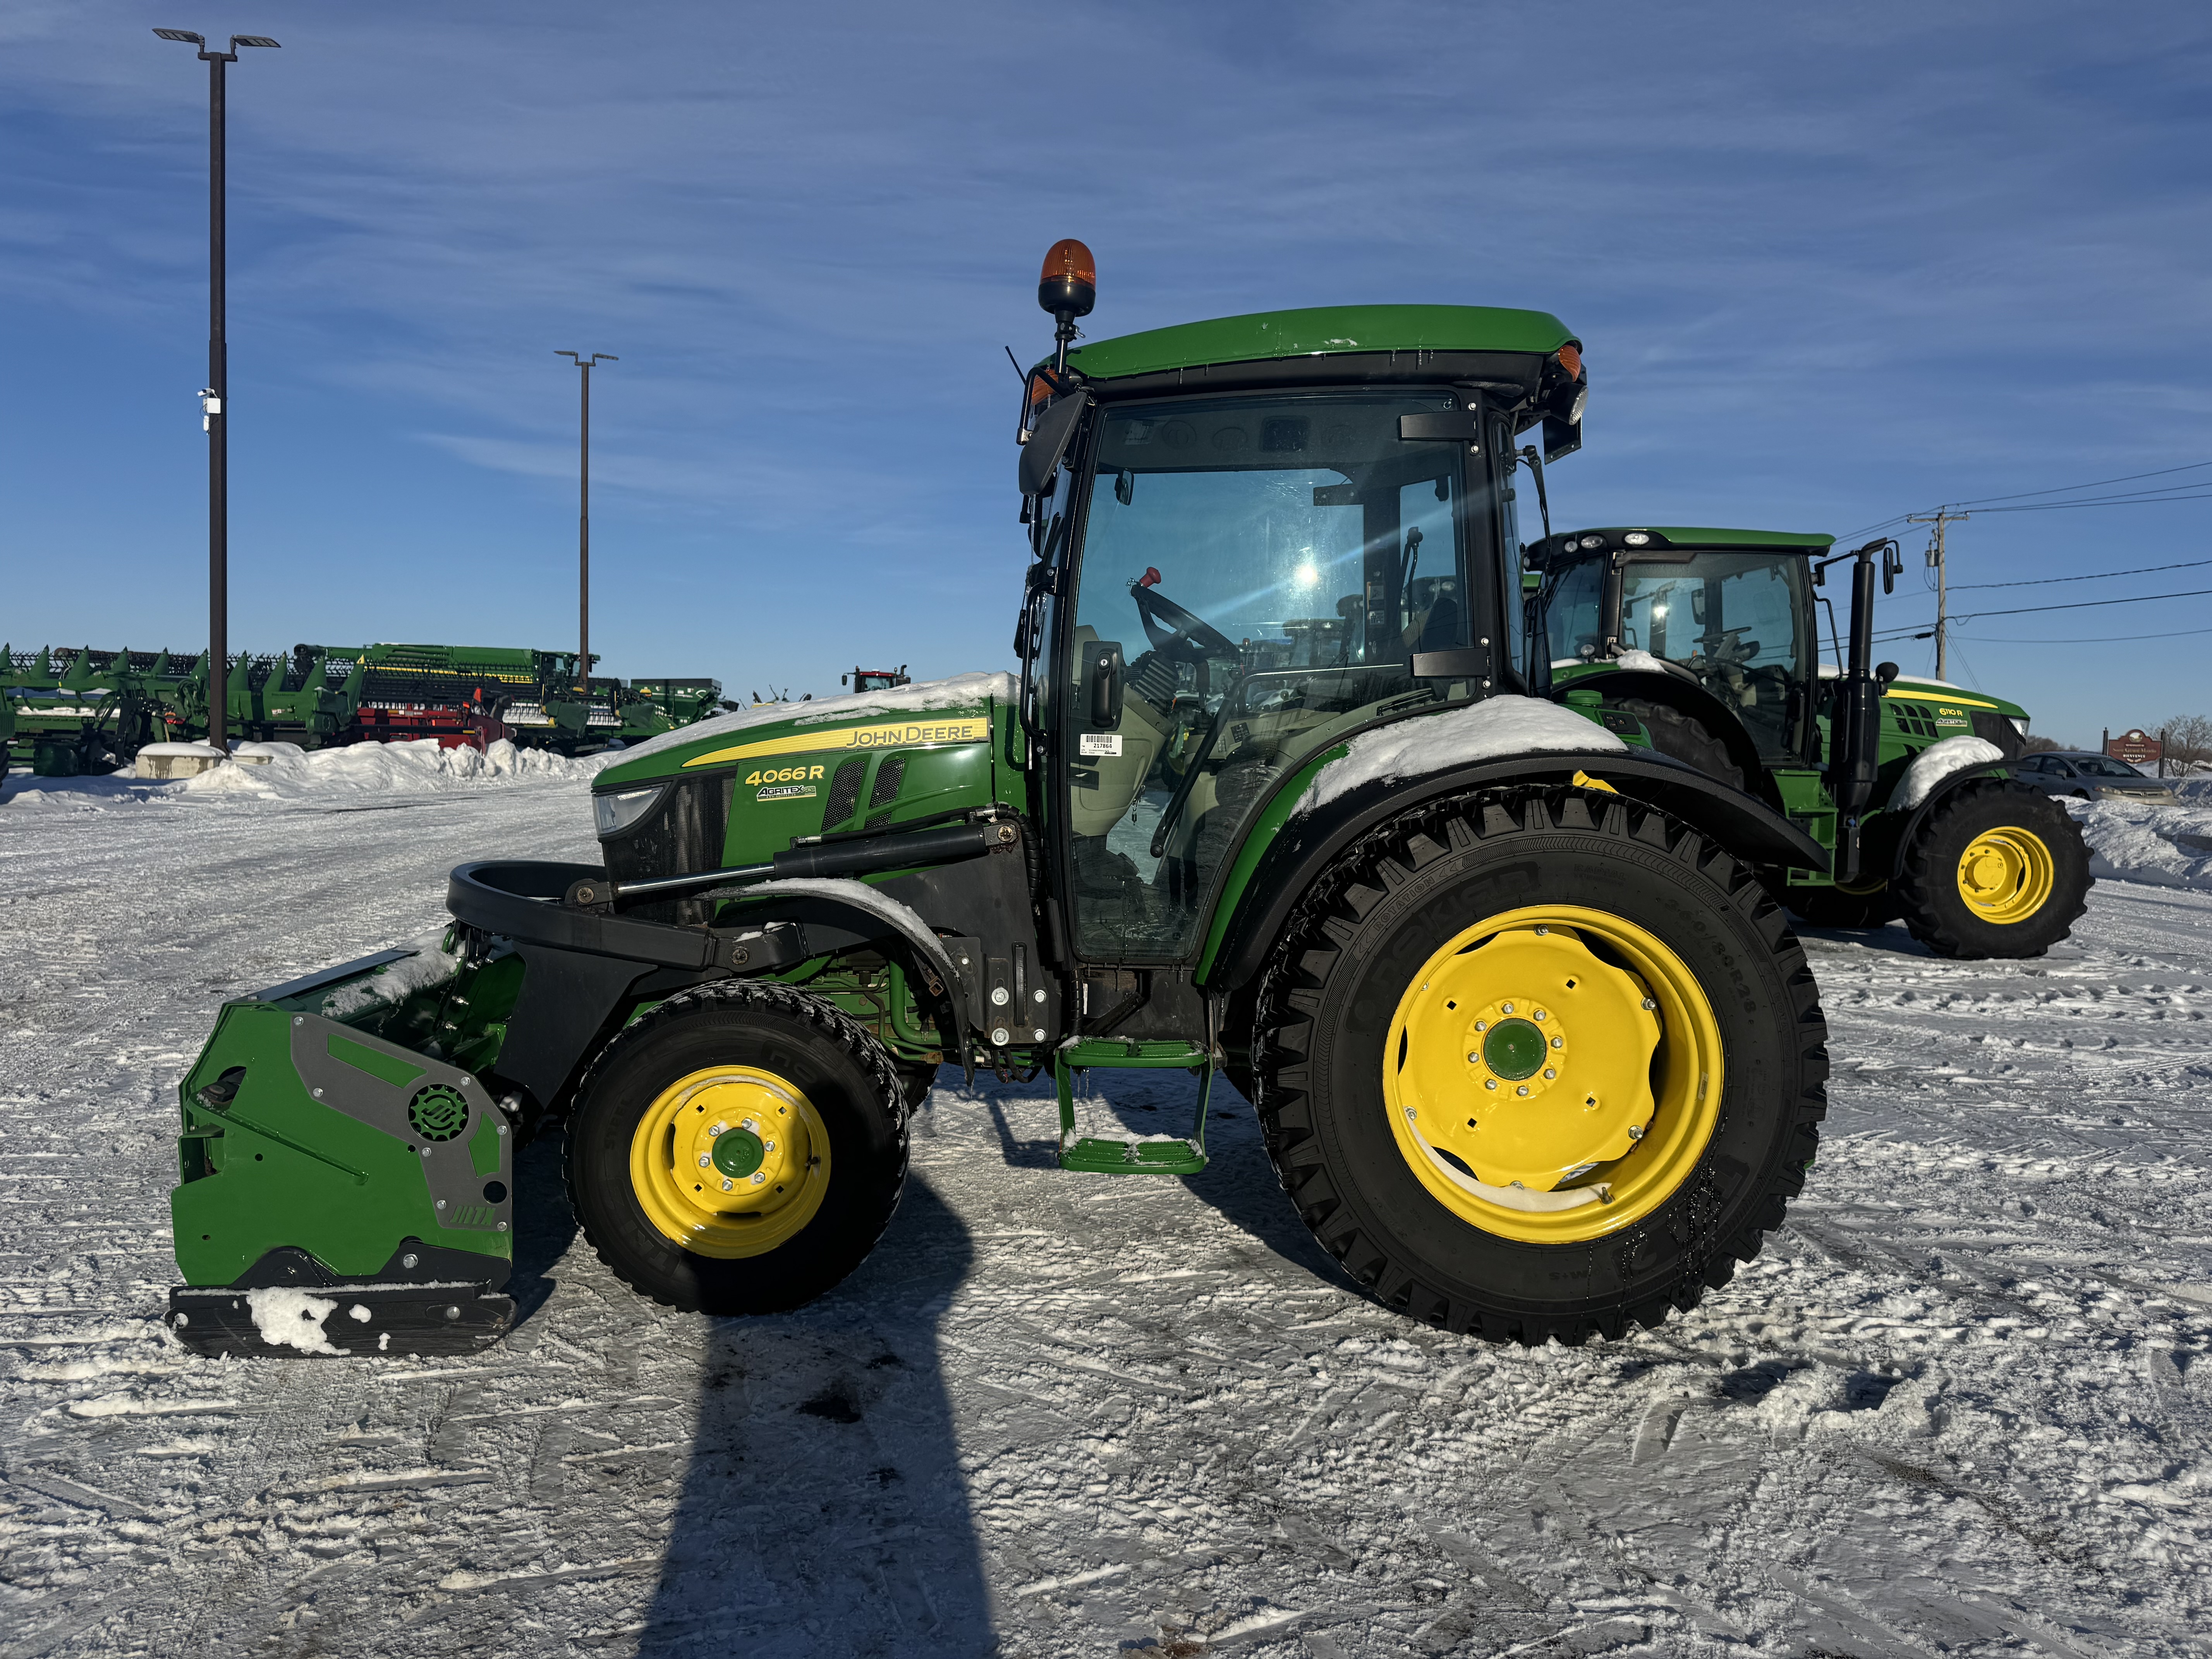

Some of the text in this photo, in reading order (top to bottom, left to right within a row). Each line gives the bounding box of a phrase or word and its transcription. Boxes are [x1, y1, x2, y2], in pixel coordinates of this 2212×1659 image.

[846, 725, 973, 746] JOHN DEERE
[745, 765, 824, 786] 4066 R
[758, 785, 803, 796] AGRITEX
[1574, 863, 1626, 882] RADIAL
[1373, 875, 1435, 932] ROTATION
[604, 1098, 632, 1150] STEEL
